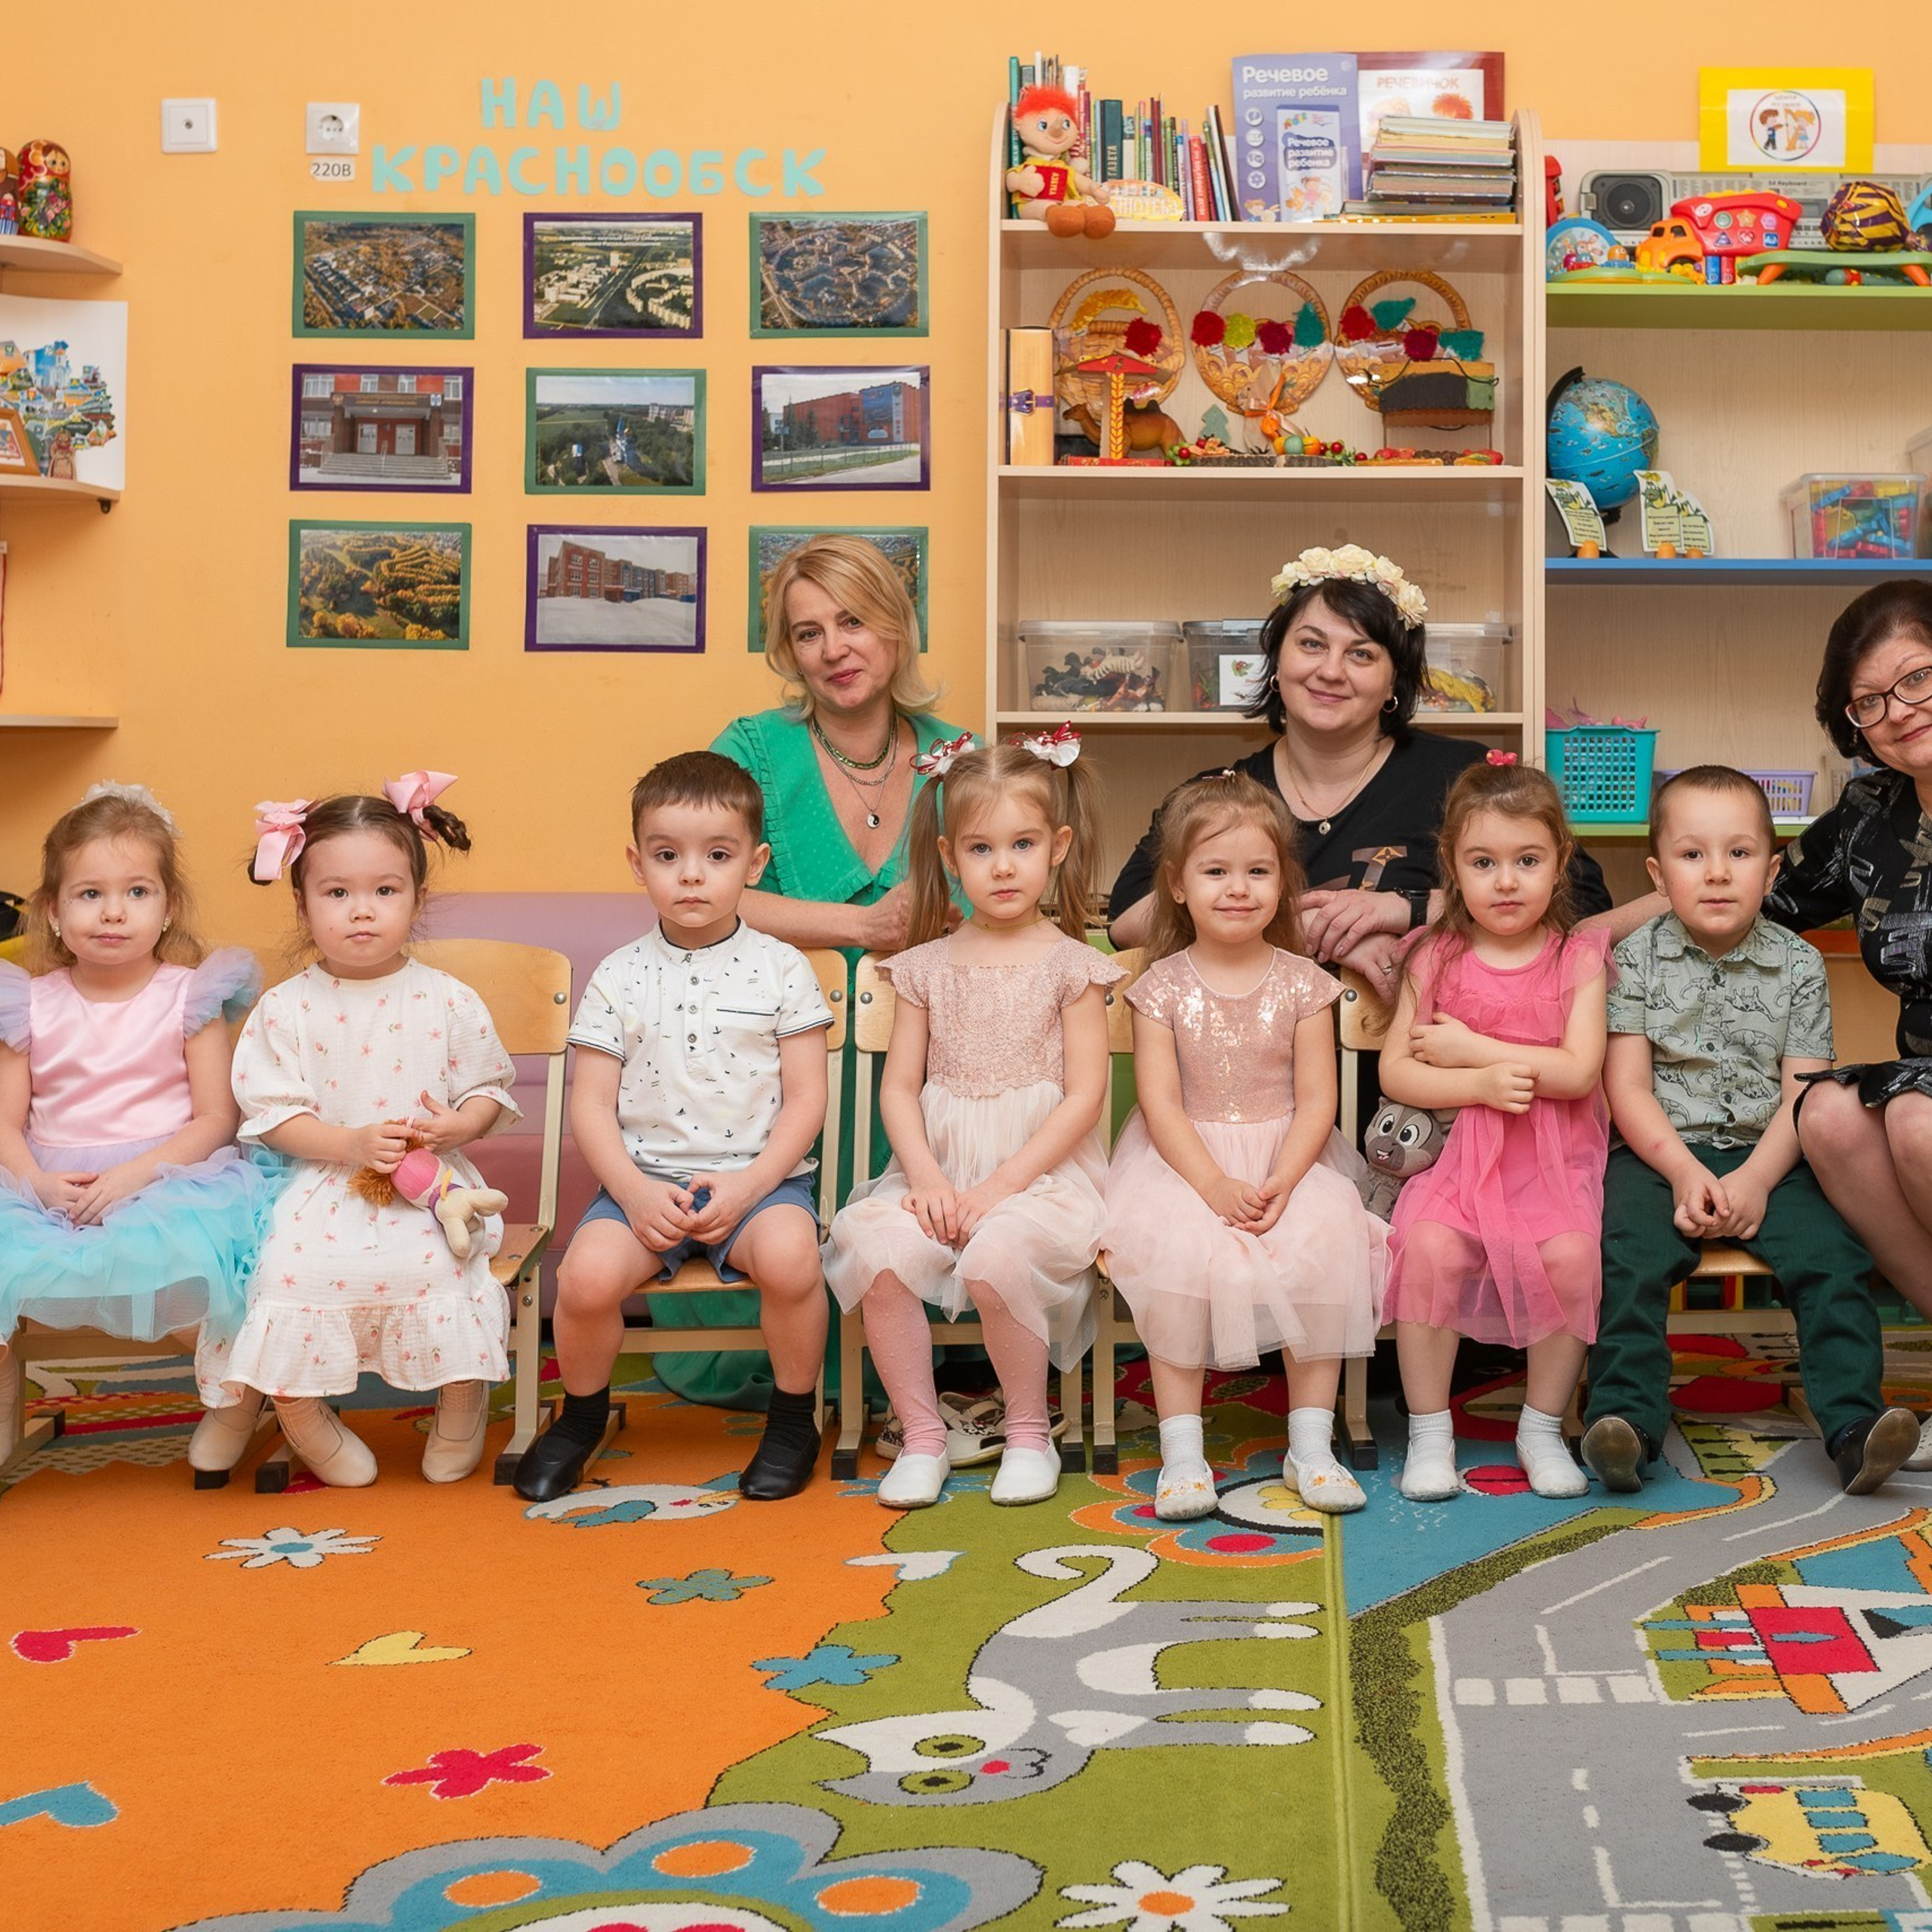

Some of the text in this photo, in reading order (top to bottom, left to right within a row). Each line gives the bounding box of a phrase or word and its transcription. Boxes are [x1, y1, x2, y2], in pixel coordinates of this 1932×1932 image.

[1242, 65, 1329, 84] Речевое
[1377, 76, 1459, 90] РЕЧЕВИЧОК
[1243, 88, 1297, 100] развитие
[481, 78, 621, 130] НАШ
[1287, 137, 1330, 147] Речевое
[1106, 144, 1118, 177] ГАЗЕТА
[1287, 148, 1334, 159] развитие
[372, 146, 826, 197] КРАСНООБСК
